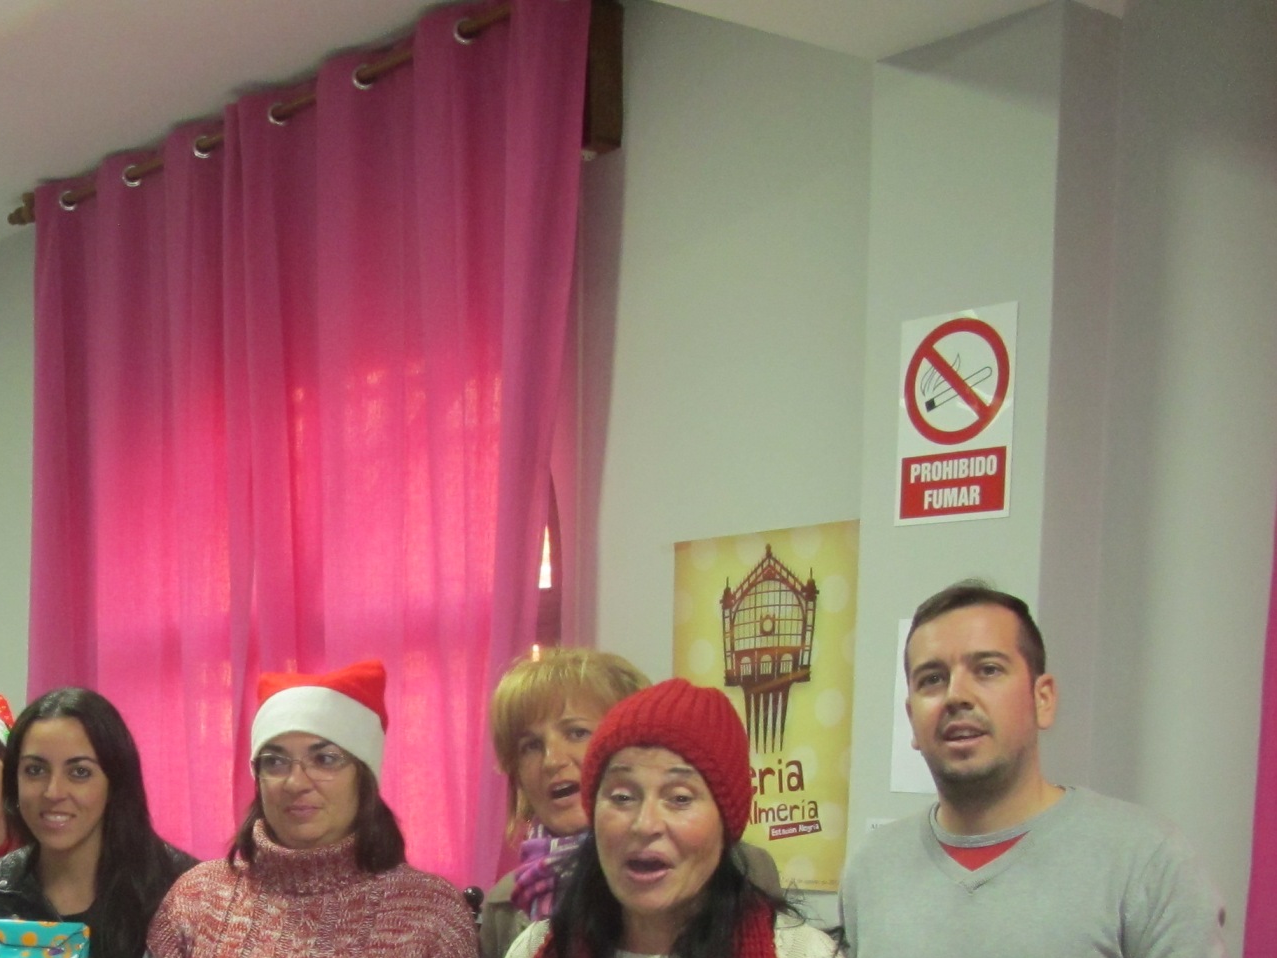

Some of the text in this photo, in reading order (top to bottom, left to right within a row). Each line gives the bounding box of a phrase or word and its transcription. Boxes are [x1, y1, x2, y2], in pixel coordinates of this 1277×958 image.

[910, 455, 997, 484] PROHIBIDO
[924, 485, 980, 510] FUMAR
[749, 759, 805, 795] eria
